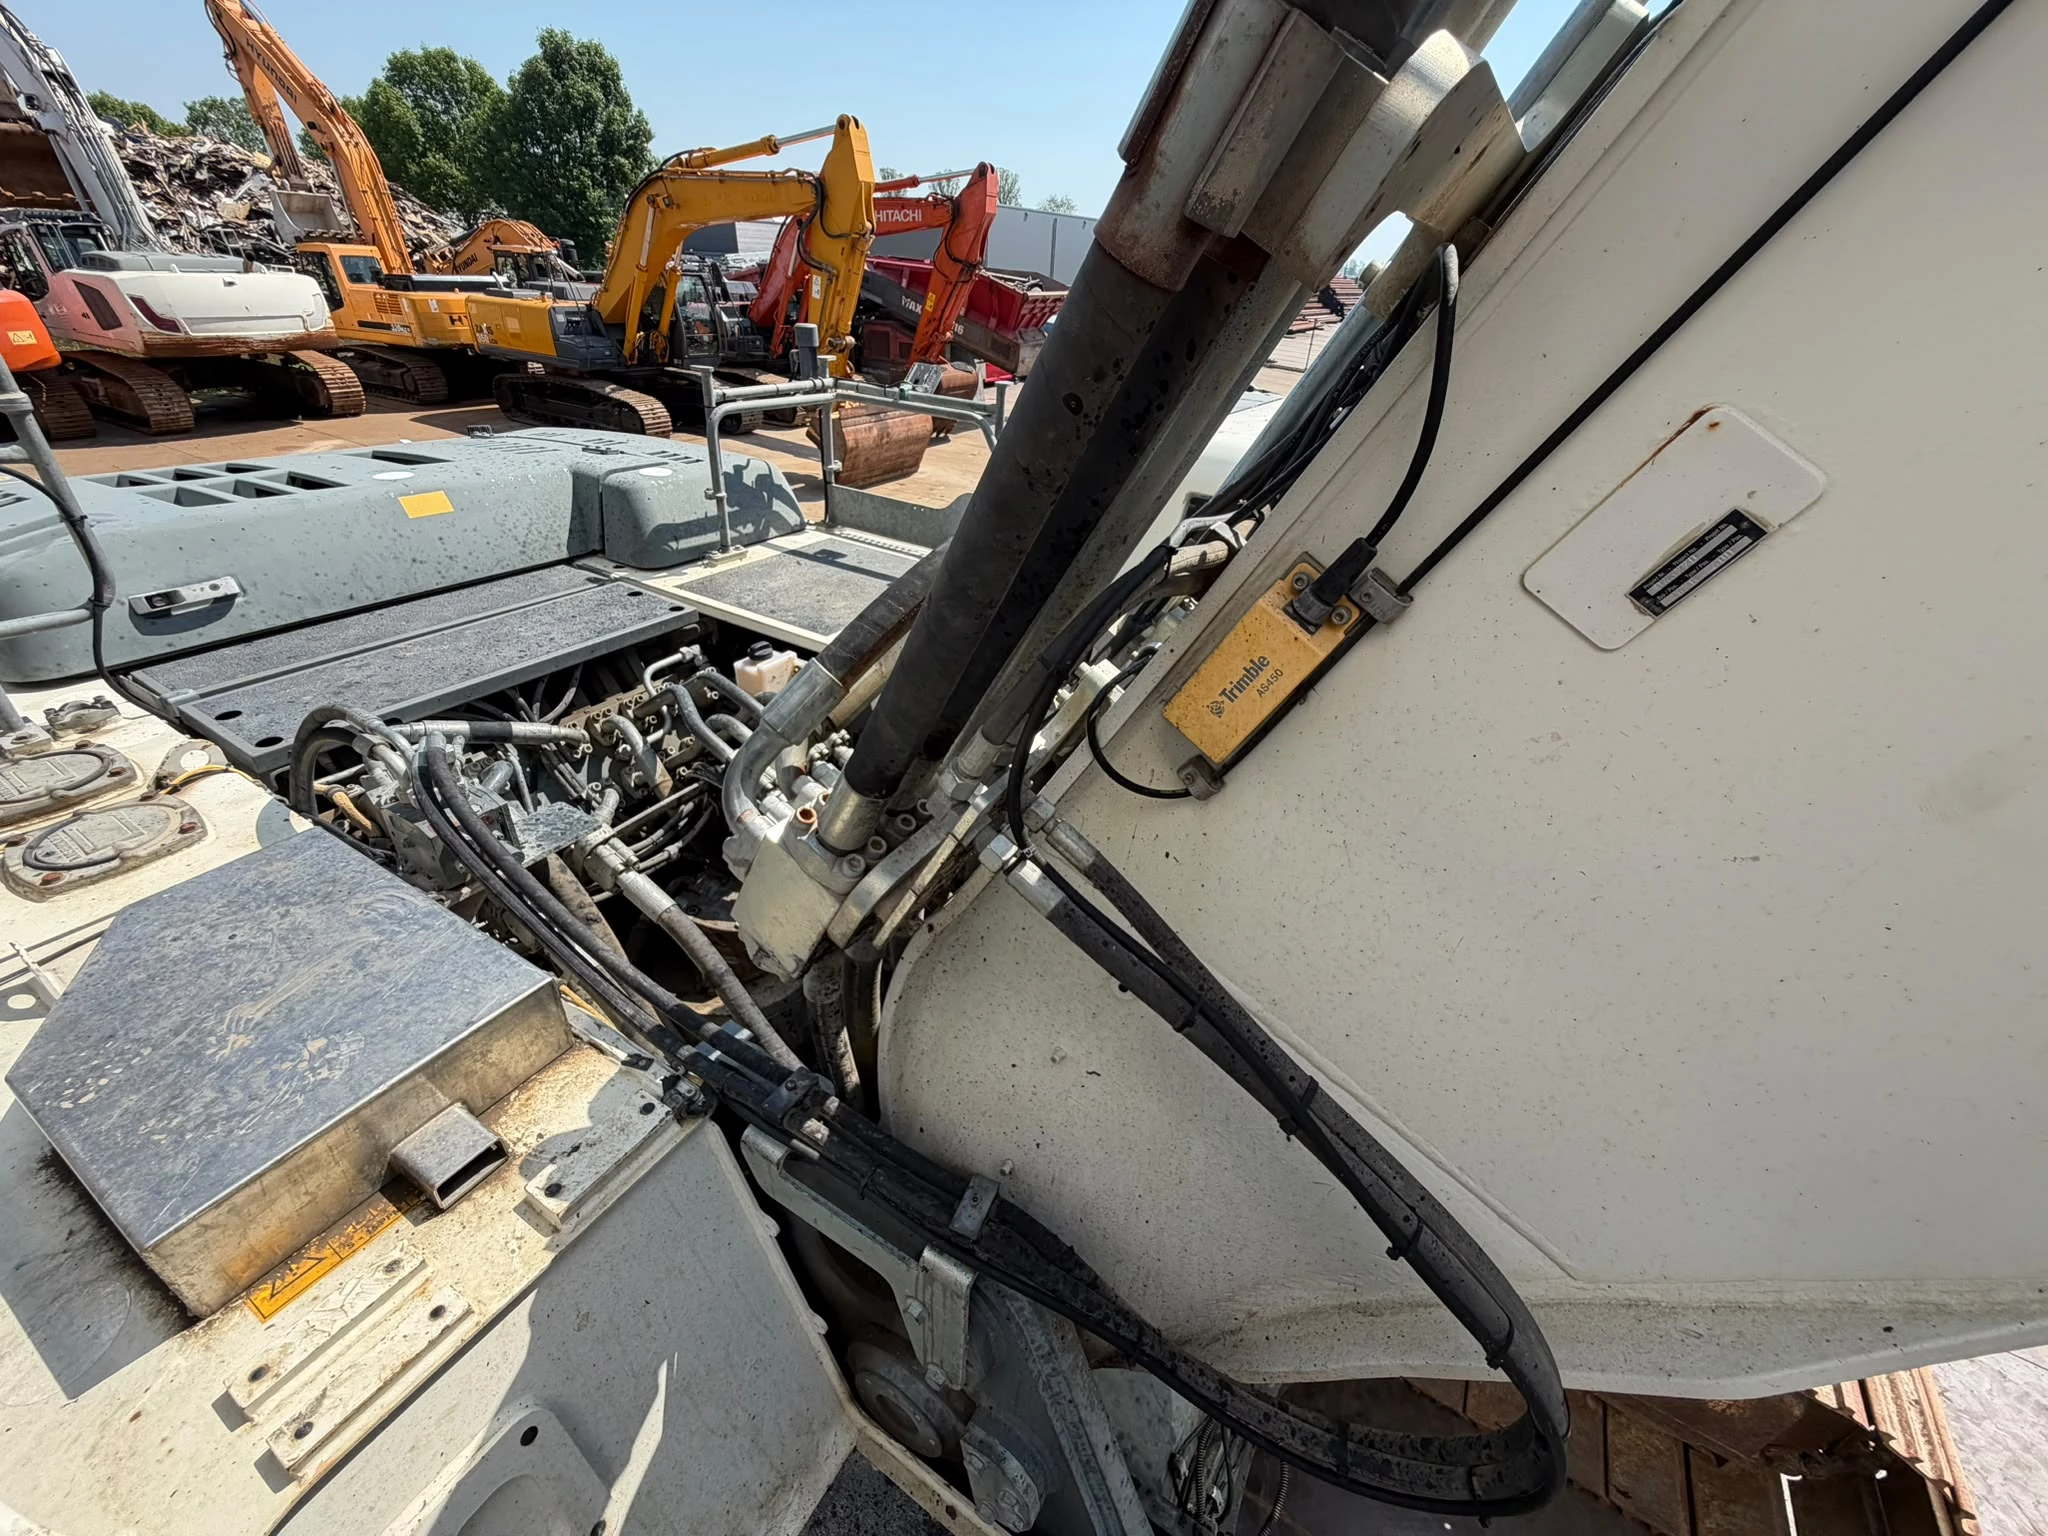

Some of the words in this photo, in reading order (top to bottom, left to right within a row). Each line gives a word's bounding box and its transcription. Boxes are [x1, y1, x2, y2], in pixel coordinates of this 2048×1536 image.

[246, 38, 297, 104] HYUNDAI
[875, 209, 922, 222] HITACHI
[1218, 655, 1270, 704] Trimble
[1256, 668, 1284, 698] AS450
